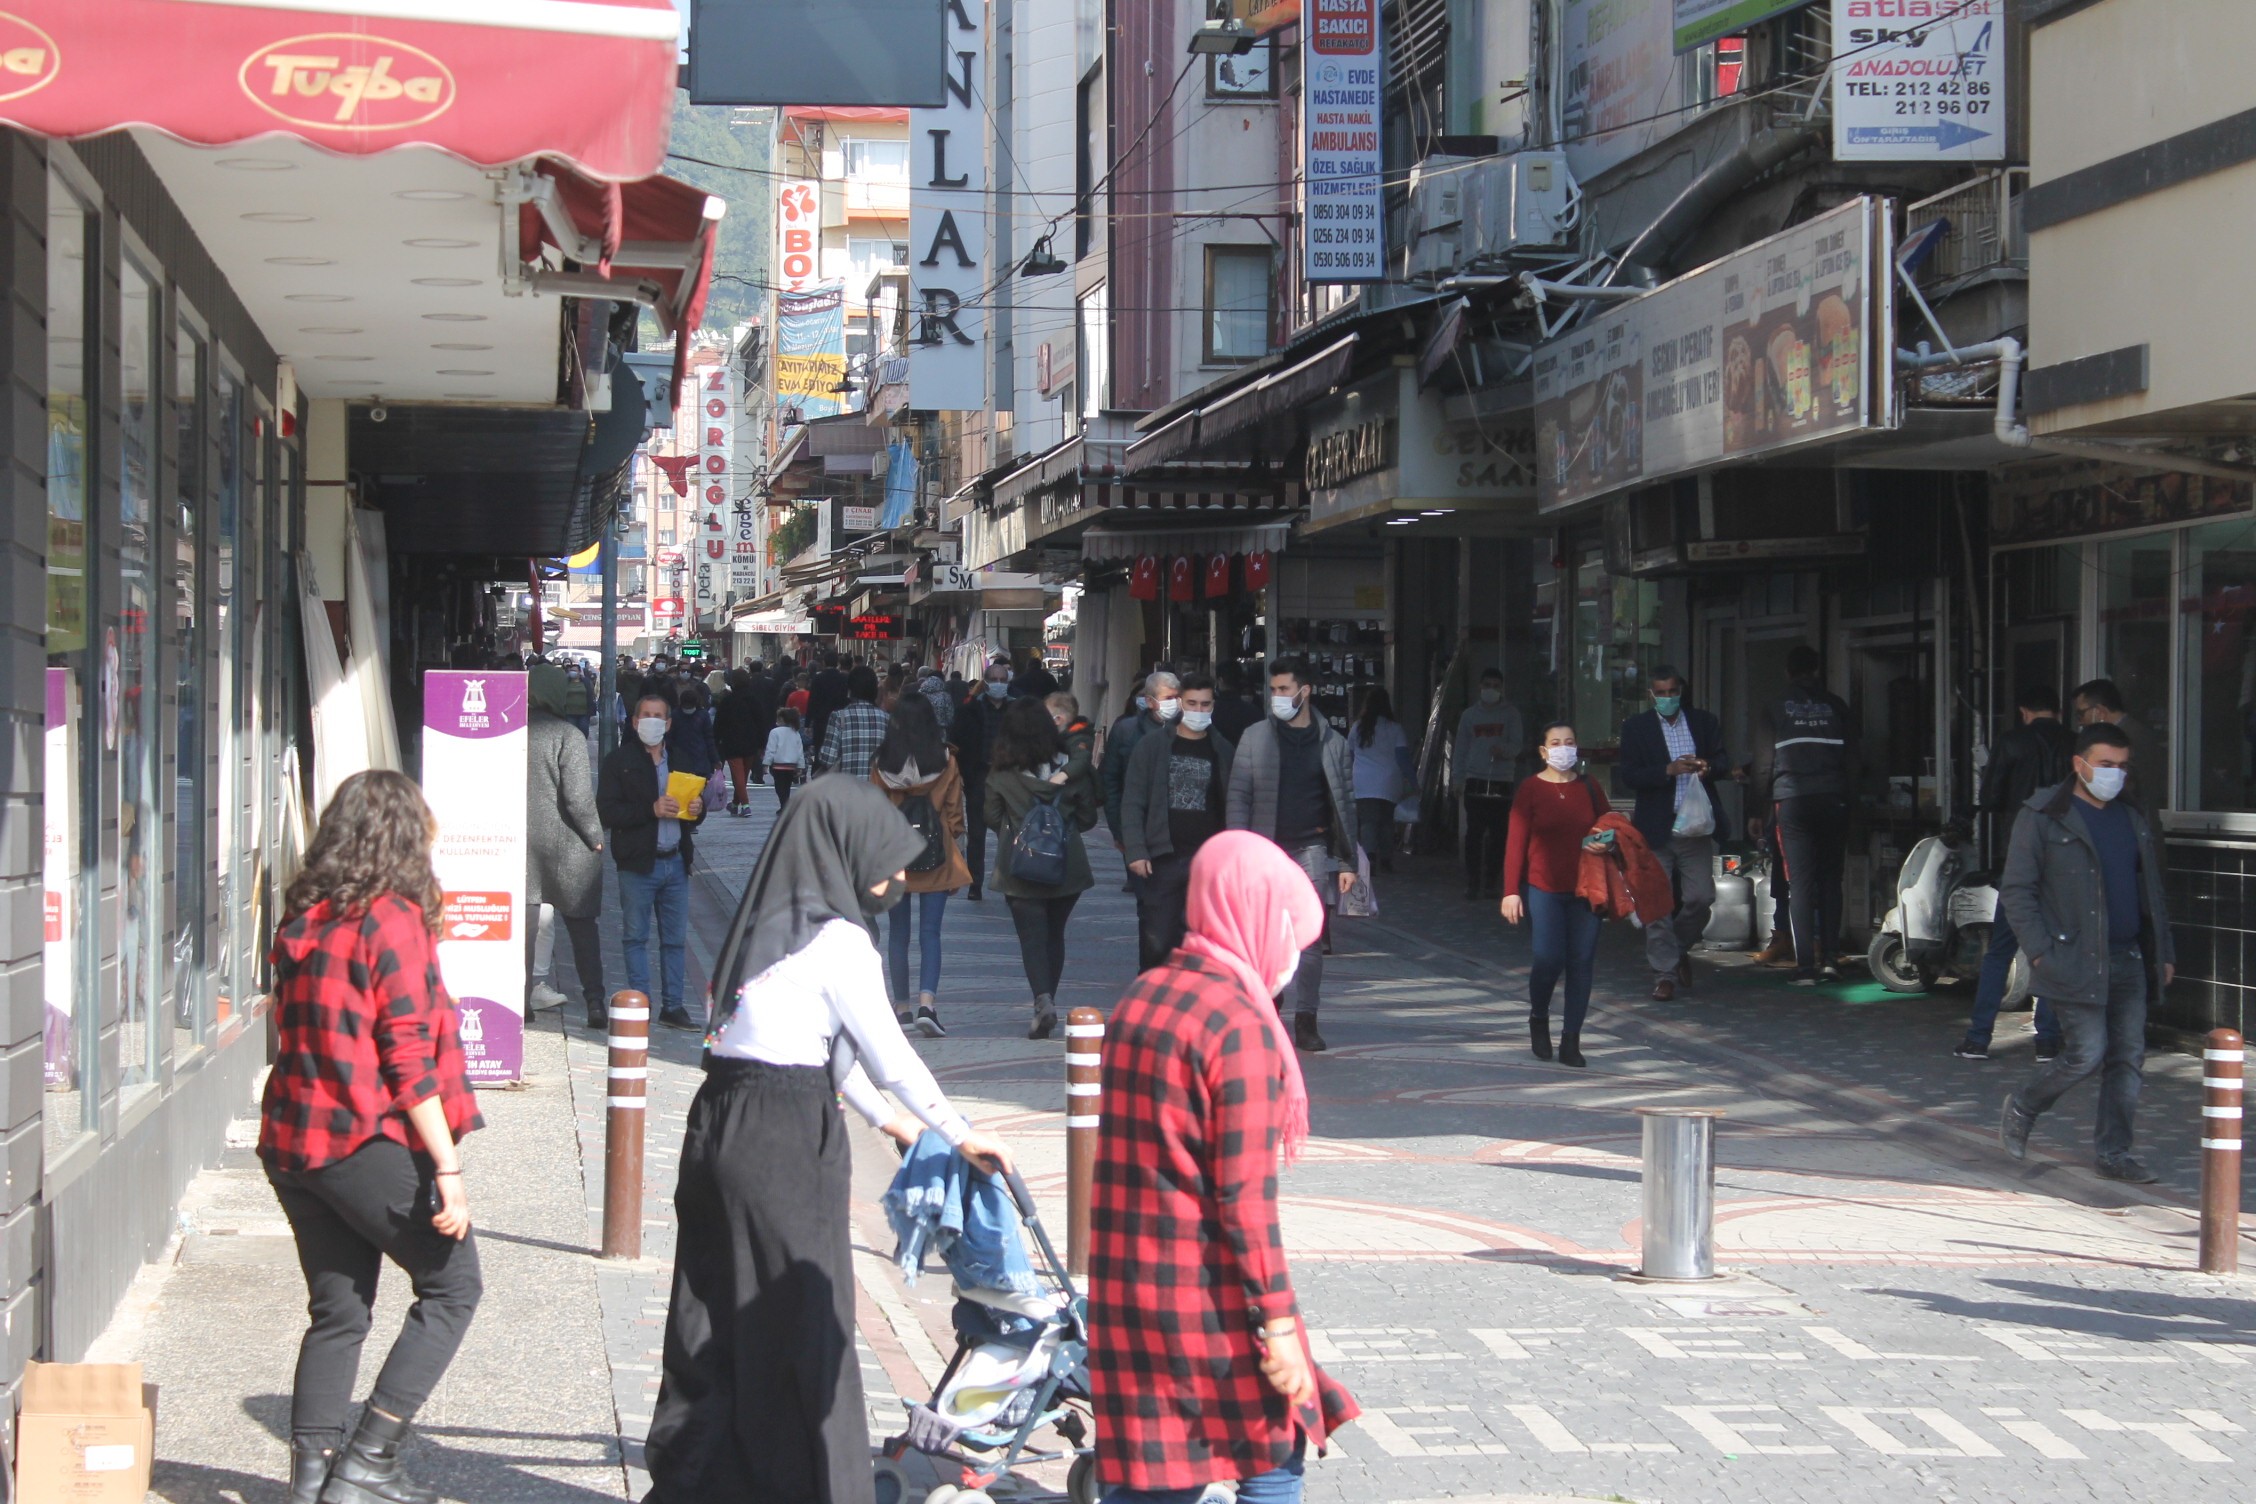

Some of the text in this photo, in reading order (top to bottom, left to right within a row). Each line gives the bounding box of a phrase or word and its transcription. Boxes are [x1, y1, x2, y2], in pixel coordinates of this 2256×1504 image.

[1319, 0, 1367, 12] HASTA
[1319, 19, 1368, 34] BAKICI
[1850, 28, 1929, 47] sky
[1847, 60, 1986, 76] ANADOLUJET
[1349, 69, 1375, 85] EVDE
[1846, 82, 1990, 96] TEL: 212 42 86
[1313, 90, 1375, 105] HASTANEDE
[1937, 101, 1961, 114] 96
[1967, 101, 1990, 114] 07
[1317, 110, 1373, 125] HASTA NAKİL
[1312, 131, 1377, 152] AMBULANSI
[1313, 157, 1376, 174] ÖZEL SAĞLIK
[1313, 204, 1375, 220] 0850 304 09 34
[1313, 228, 1375, 244] 0256 234 09 34
[1313, 252, 1375, 268] 0530 506 09 34
[706, 371, 725, 559] ZOROĞLU
[732, 555, 756, 564] KÖMÜ
[752, 623, 796, 632] SİBEL GİYİM
[456, 895, 486, 903] LÜTFEN
[463, 904, 509, 912] MUSLUĞUN
[479, 1060, 502, 1069] ATAY
